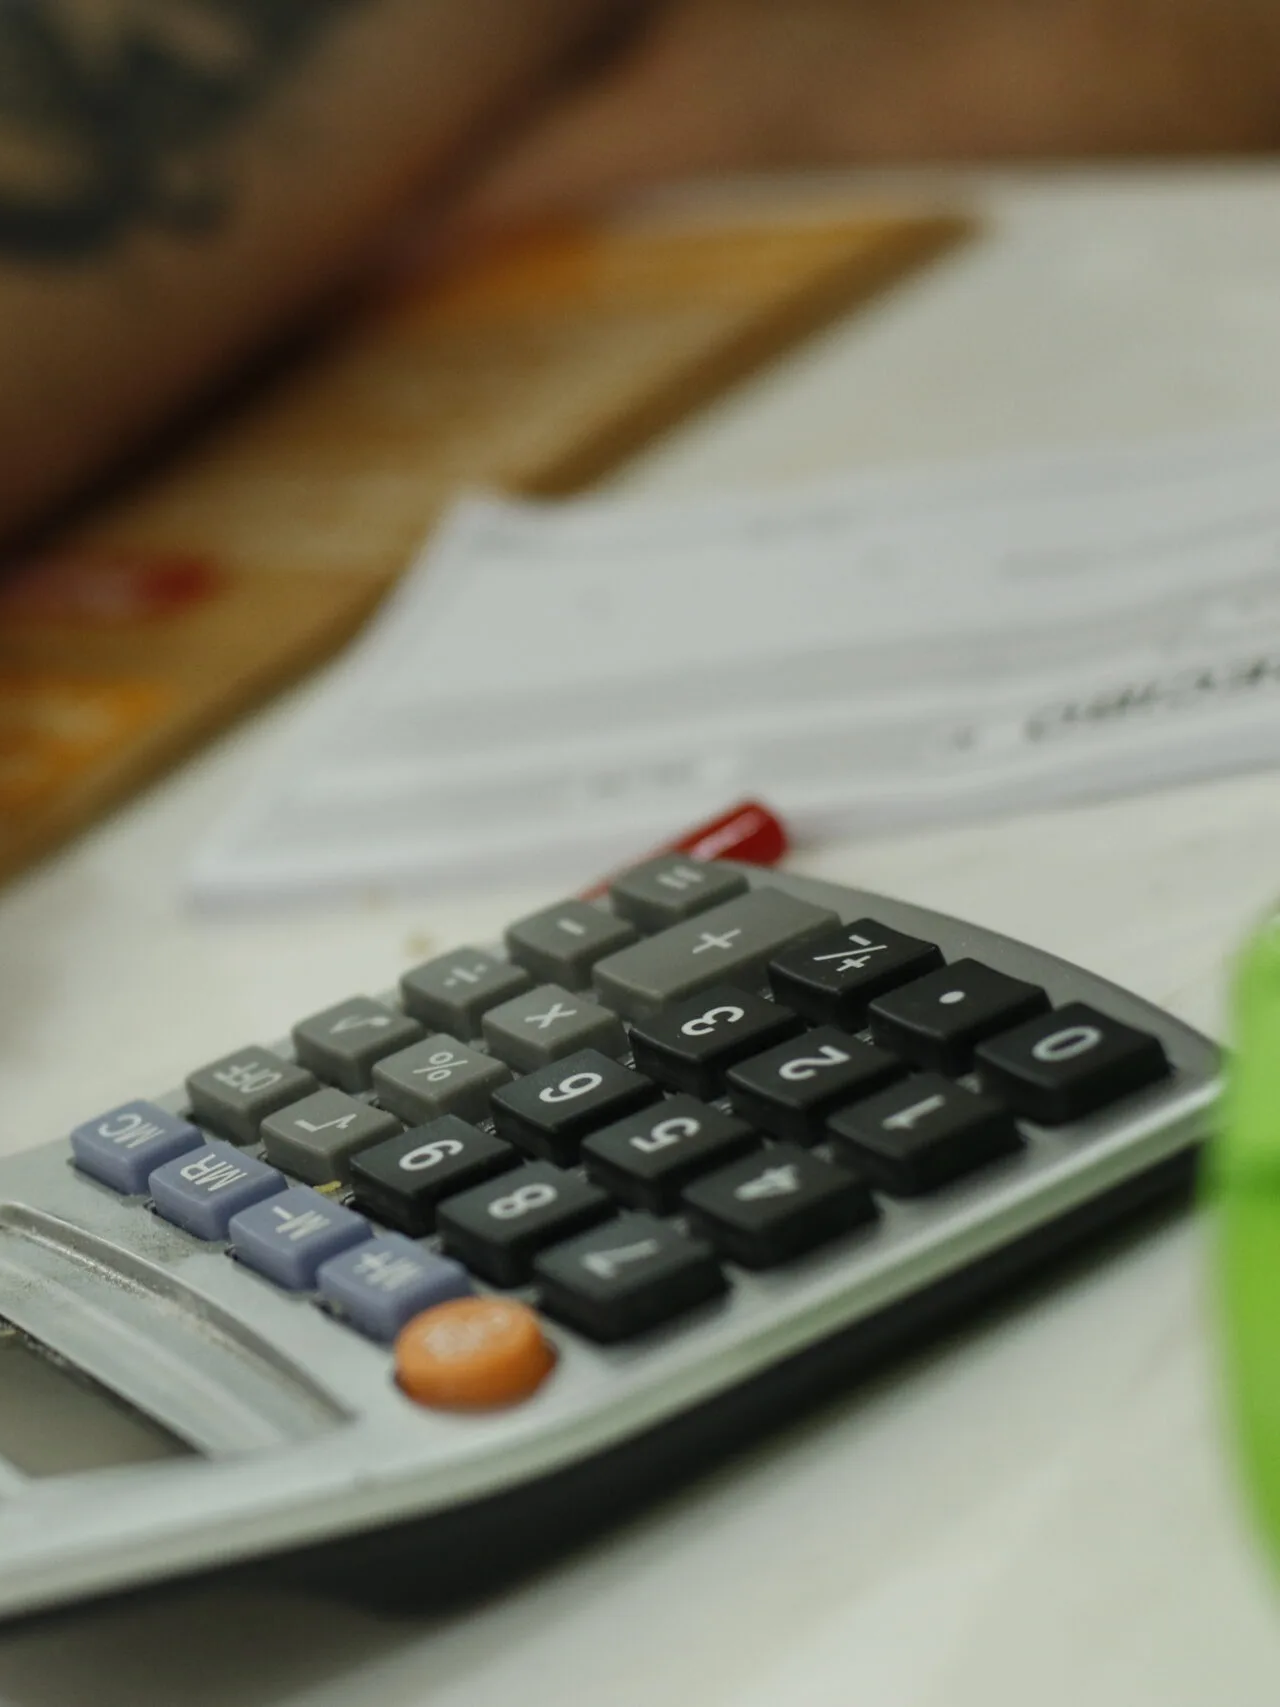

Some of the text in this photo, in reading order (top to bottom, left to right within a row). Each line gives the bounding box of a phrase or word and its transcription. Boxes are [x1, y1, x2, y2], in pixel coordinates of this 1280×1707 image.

[691, 928, 742, 954] +
[681, 1007, 744, 1035] 3
[1031, 1026, 1102, 1061] 0
[213, 1060, 282, 1095] OFF
[411, 1051, 469, 1082] %
[777, 1045, 851, 1080] 2
[539, 1073, 602, 1102] 6
[882, 1094, 945, 1130] 1
[97, 1112, 166, 1149] MC
[631, 1118, 698, 1151] 5
[178, 1153, 249, 1192] MR
[398, 1139, 465, 1171] 9
[735, 1165, 799, 1200] 4
[487, 1184, 557, 1218] 8
[352, 1249, 422, 1292] M+
[581, 1239, 658, 1278] 7
